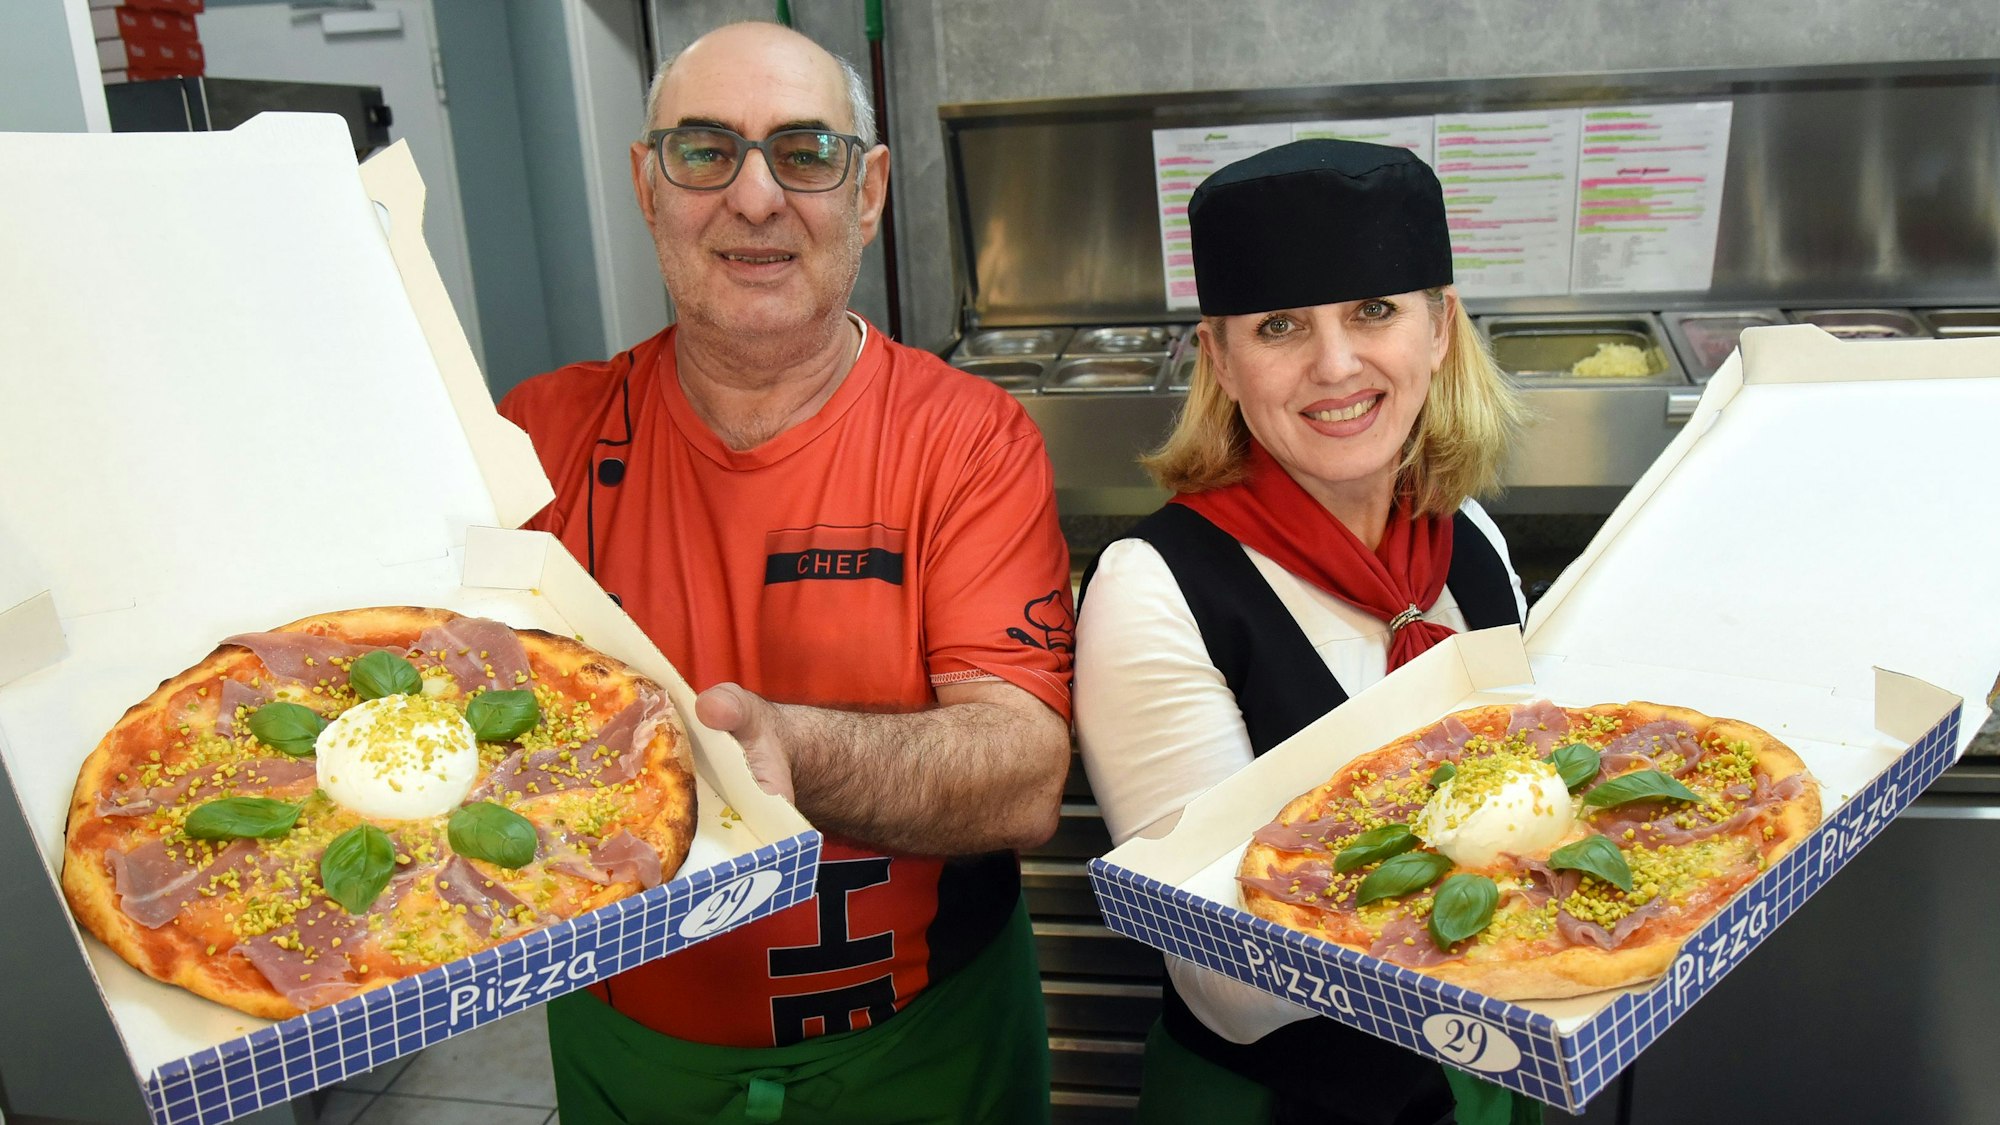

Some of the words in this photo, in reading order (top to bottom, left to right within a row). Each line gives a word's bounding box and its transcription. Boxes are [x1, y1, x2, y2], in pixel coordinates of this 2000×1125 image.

[797, 552, 870, 575] CHEF
[1818, 784, 1899, 877] Pizza
[694, 876, 755, 933] 29
[449, 950, 598, 1026] Pizza
[1242, 938, 1357, 1017] Pizza
[1674, 901, 1768, 1007] Pizza
[1441, 1018, 1489, 1067] 29
